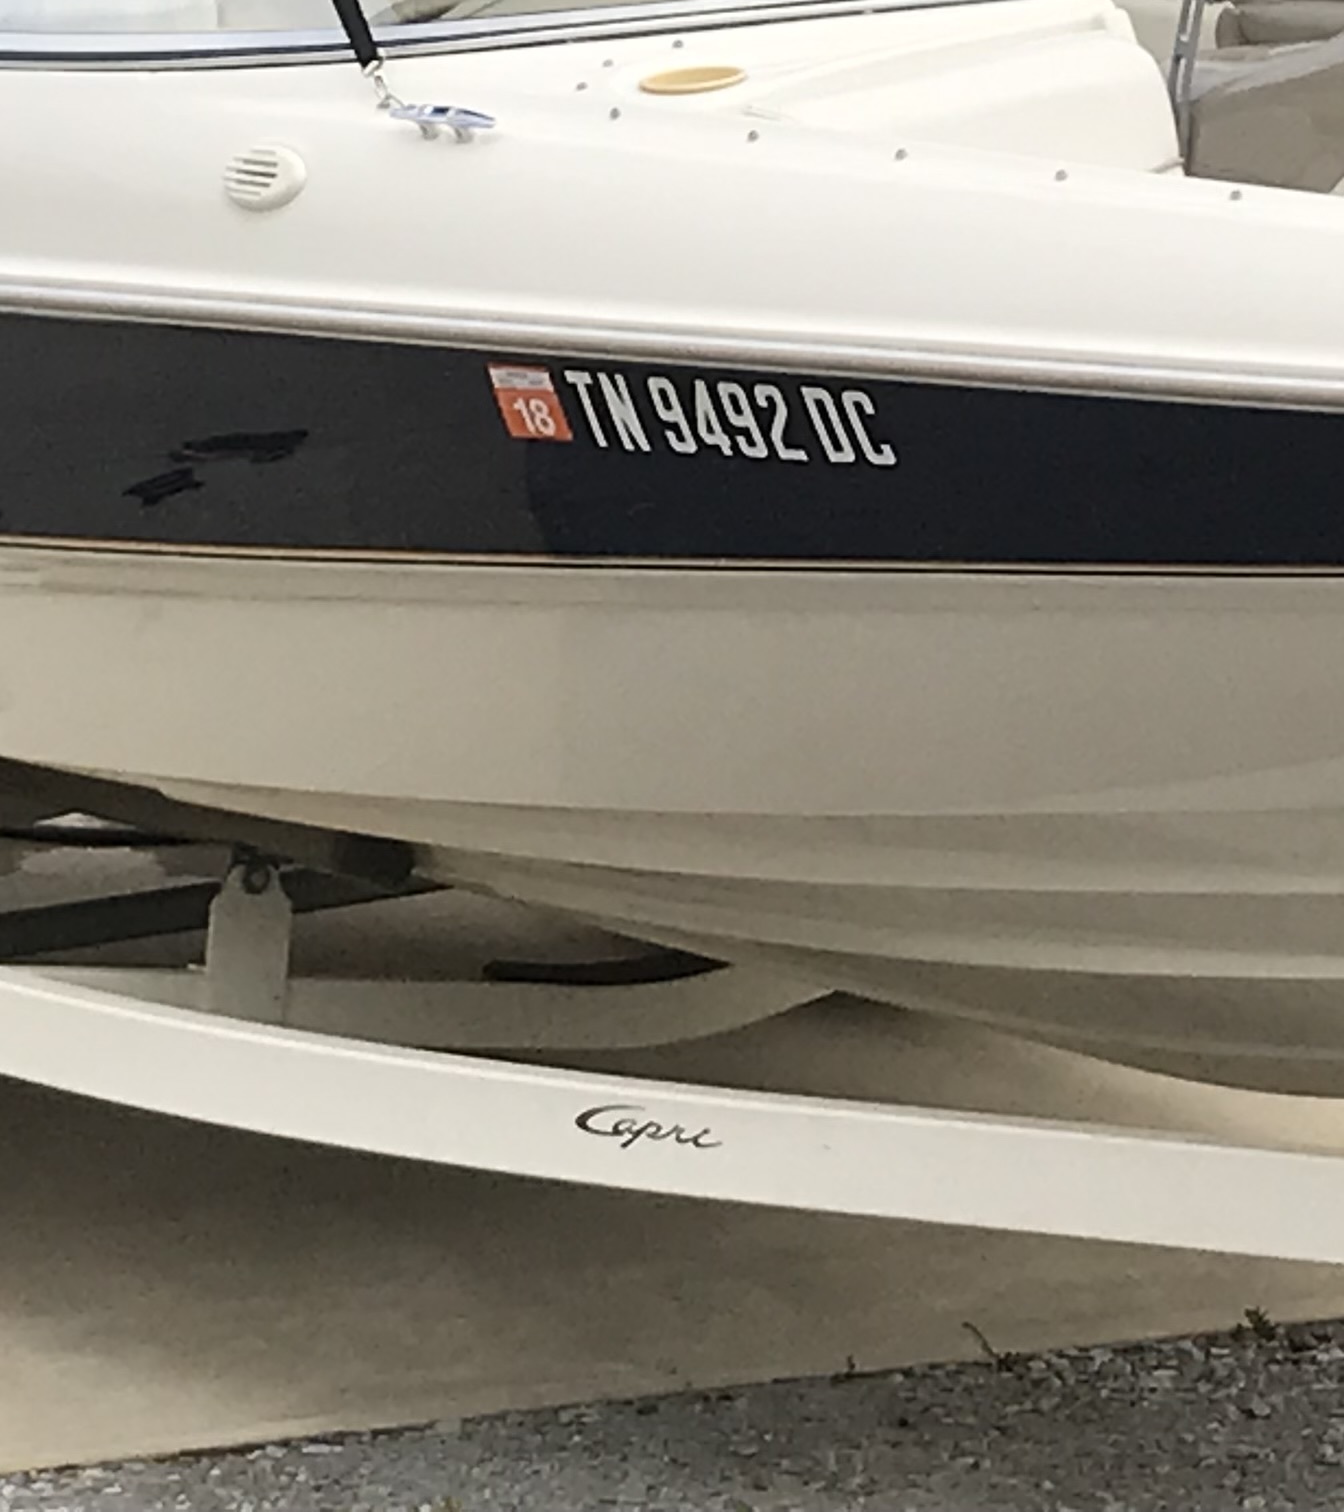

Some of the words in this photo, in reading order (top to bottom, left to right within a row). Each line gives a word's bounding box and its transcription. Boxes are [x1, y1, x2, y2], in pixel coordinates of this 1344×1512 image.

[513, 397, 556, 438] 18
[562, 369, 651, 453] TN
[648, 376, 809, 462] 9492
[800, 386, 897, 466] DC
[574, 1104, 723, 1150] Capri
